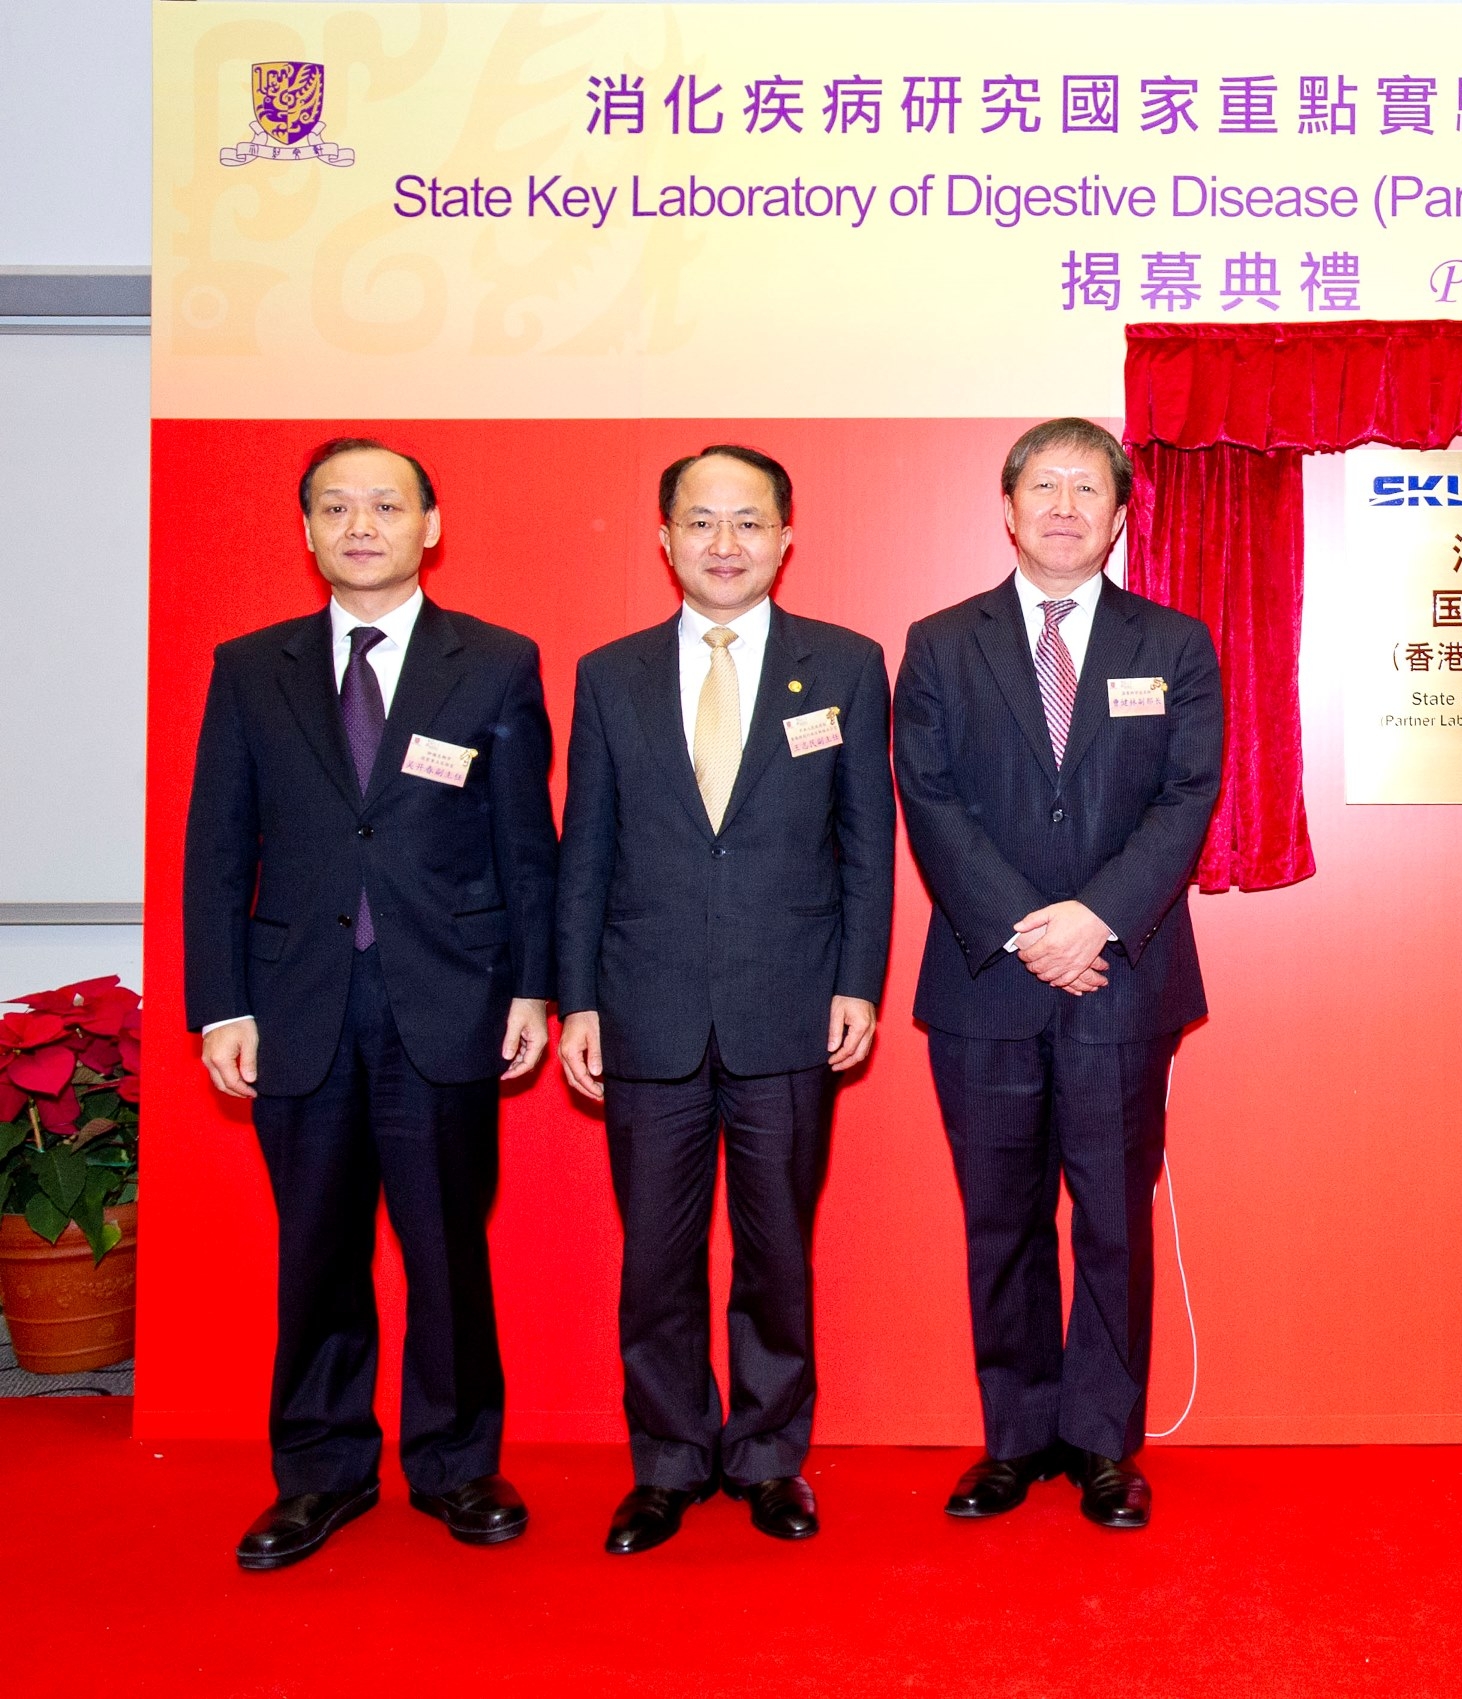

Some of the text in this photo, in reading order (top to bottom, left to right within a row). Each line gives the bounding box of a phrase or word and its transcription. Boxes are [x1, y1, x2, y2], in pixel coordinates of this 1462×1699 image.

[394, 175, 512, 217] State
[528, 175, 617, 229] Key
[632, 175, 876, 228] Laboratory
[890, 174, 935, 216] of
[948, 175, 1155, 227] Digestive
[1173, 176, 1358, 217] Disease
[1062, 250, 1364, 314] 揭幕典禮
[1412, 692, 1455, 705] State
[1381, 714, 1436, 727] (Partner
